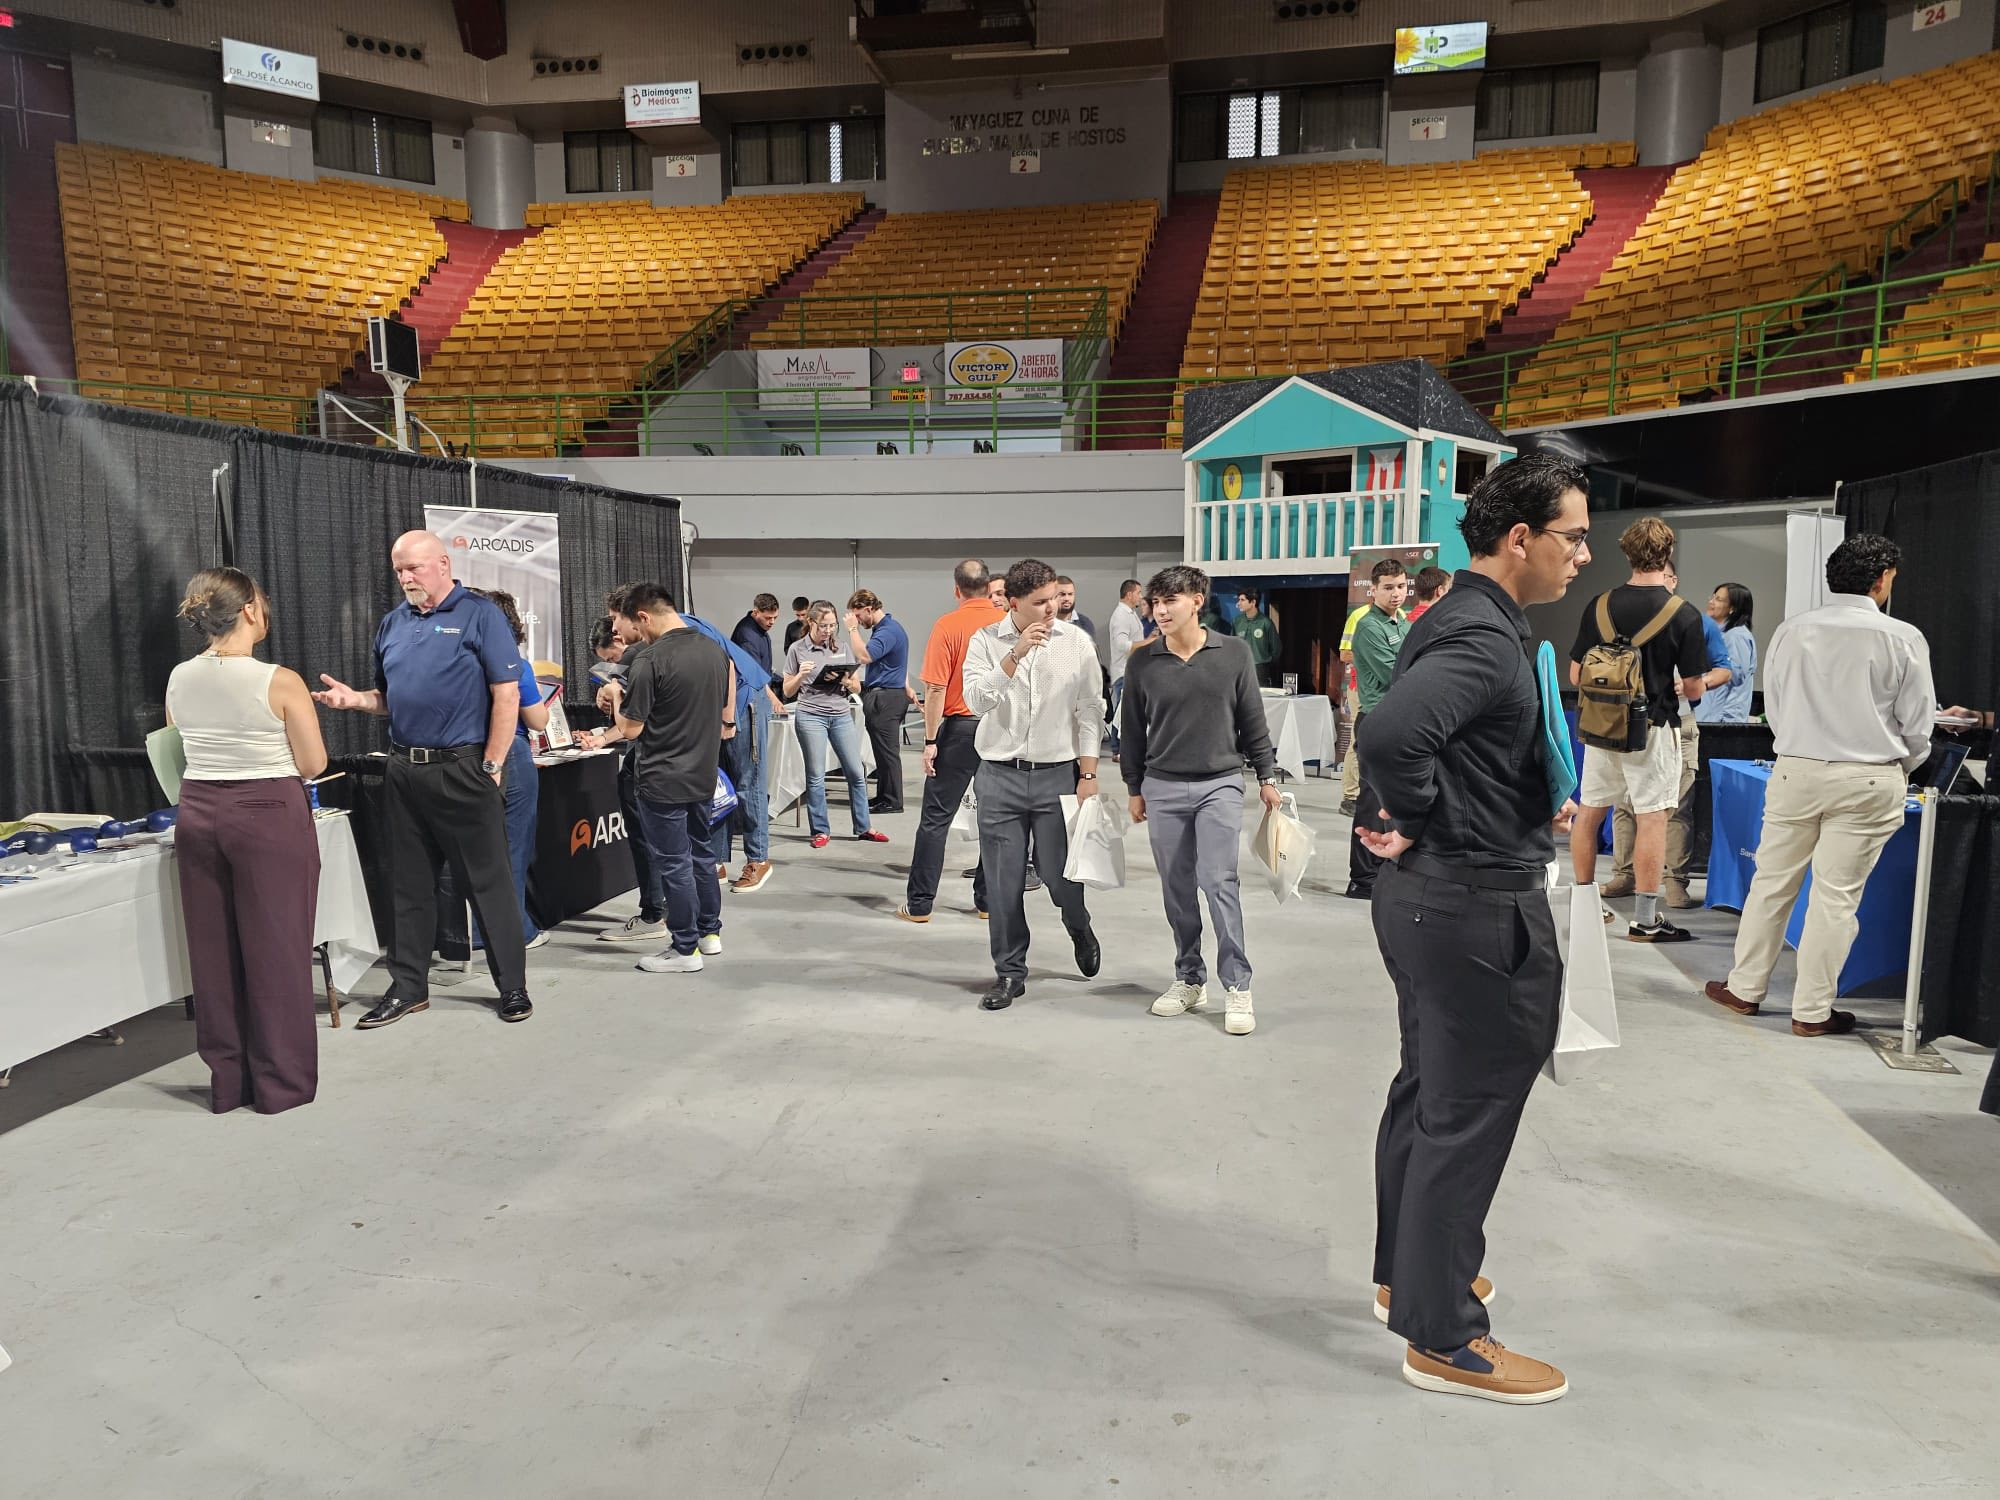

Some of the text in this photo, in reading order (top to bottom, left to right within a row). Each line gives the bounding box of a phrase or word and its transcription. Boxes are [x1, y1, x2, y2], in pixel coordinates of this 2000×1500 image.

[1924, 5, 1945, 26] 24
[1080, 106, 1100, 124] DE
[1067, 127, 1126, 147] HOSTOS
[1423, 126, 1430, 139] 1
[678, 163, 685, 176] 3
[1019, 159, 1027, 172] 2
[1021, 354, 1056, 367] ABIERTO
[957, 363, 1009, 372] VICTORY
[1018, 366, 1059, 379] 24 HORAS
[967, 374, 999, 383] GULF
[948, 391, 1002, 401] 787.834.584
[469, 537, 535, 553] ARCADIS
